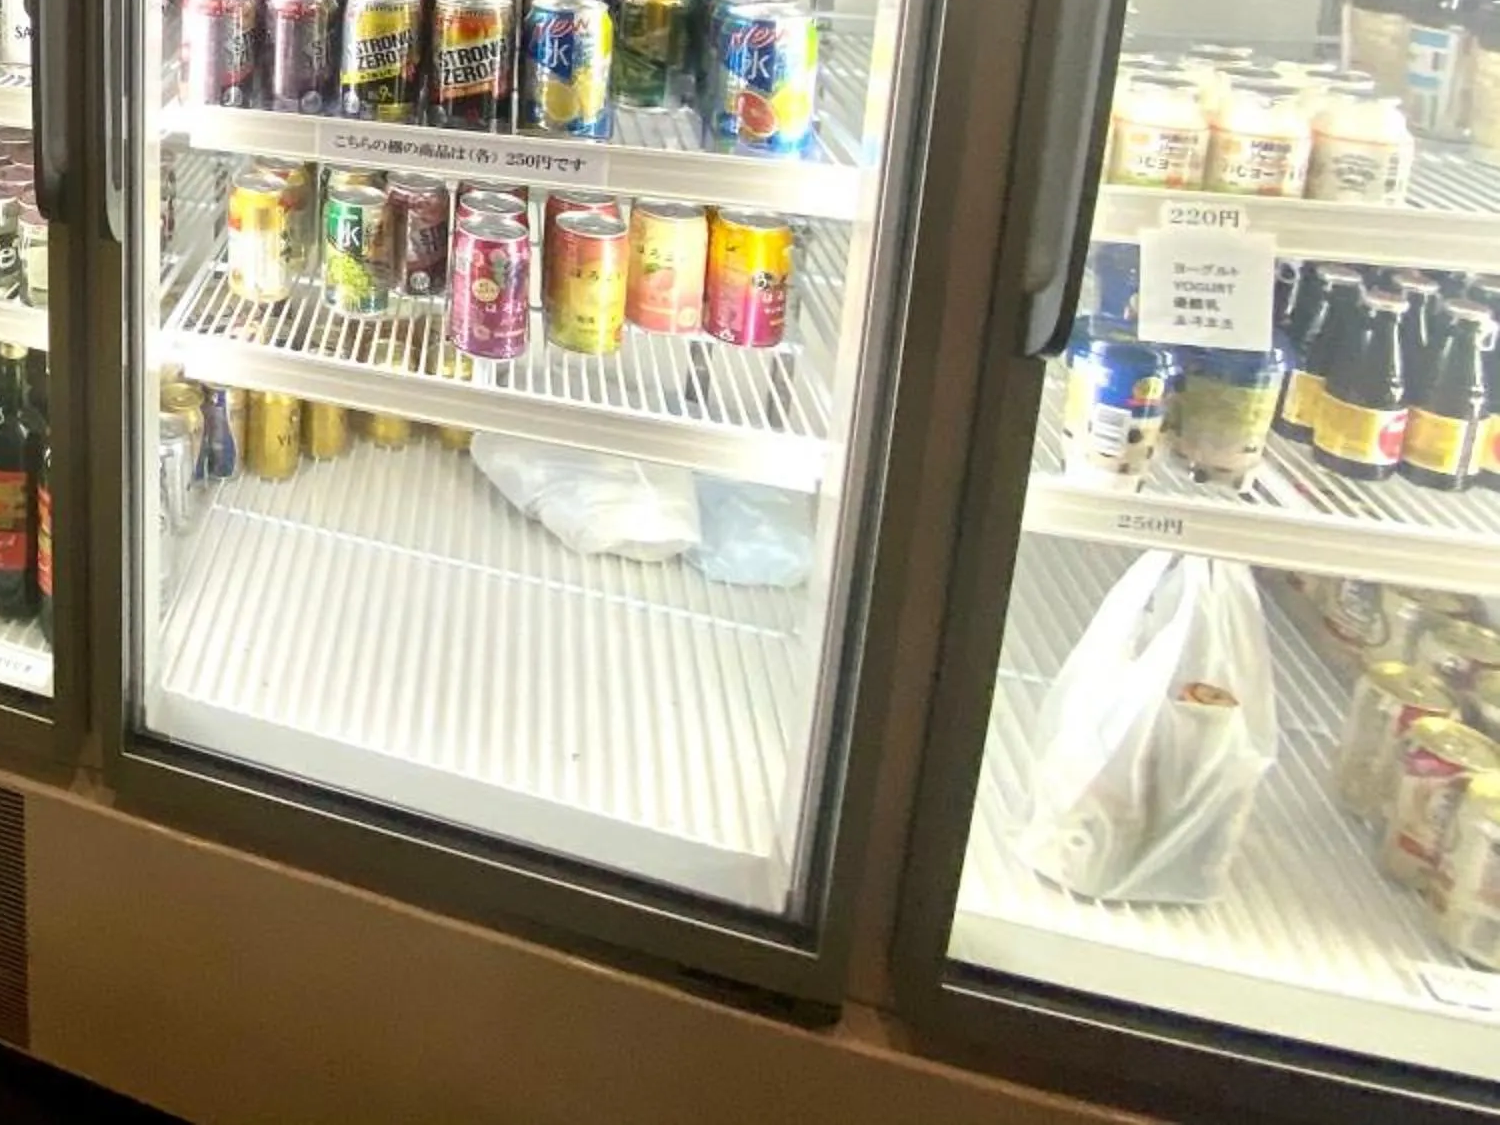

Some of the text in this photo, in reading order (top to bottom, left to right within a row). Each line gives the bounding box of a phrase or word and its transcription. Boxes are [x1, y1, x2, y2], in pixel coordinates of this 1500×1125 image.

[358, 50, 397, 70] ZERO
[438, 38, 507, 68] STRONG
[442, 60, 490, 86] ZERO
[1168, 208, 1240, 228] 220円
[1172, 280, 1236, 295] YOGURT
[1116, 513, 1184, 536] 250円
